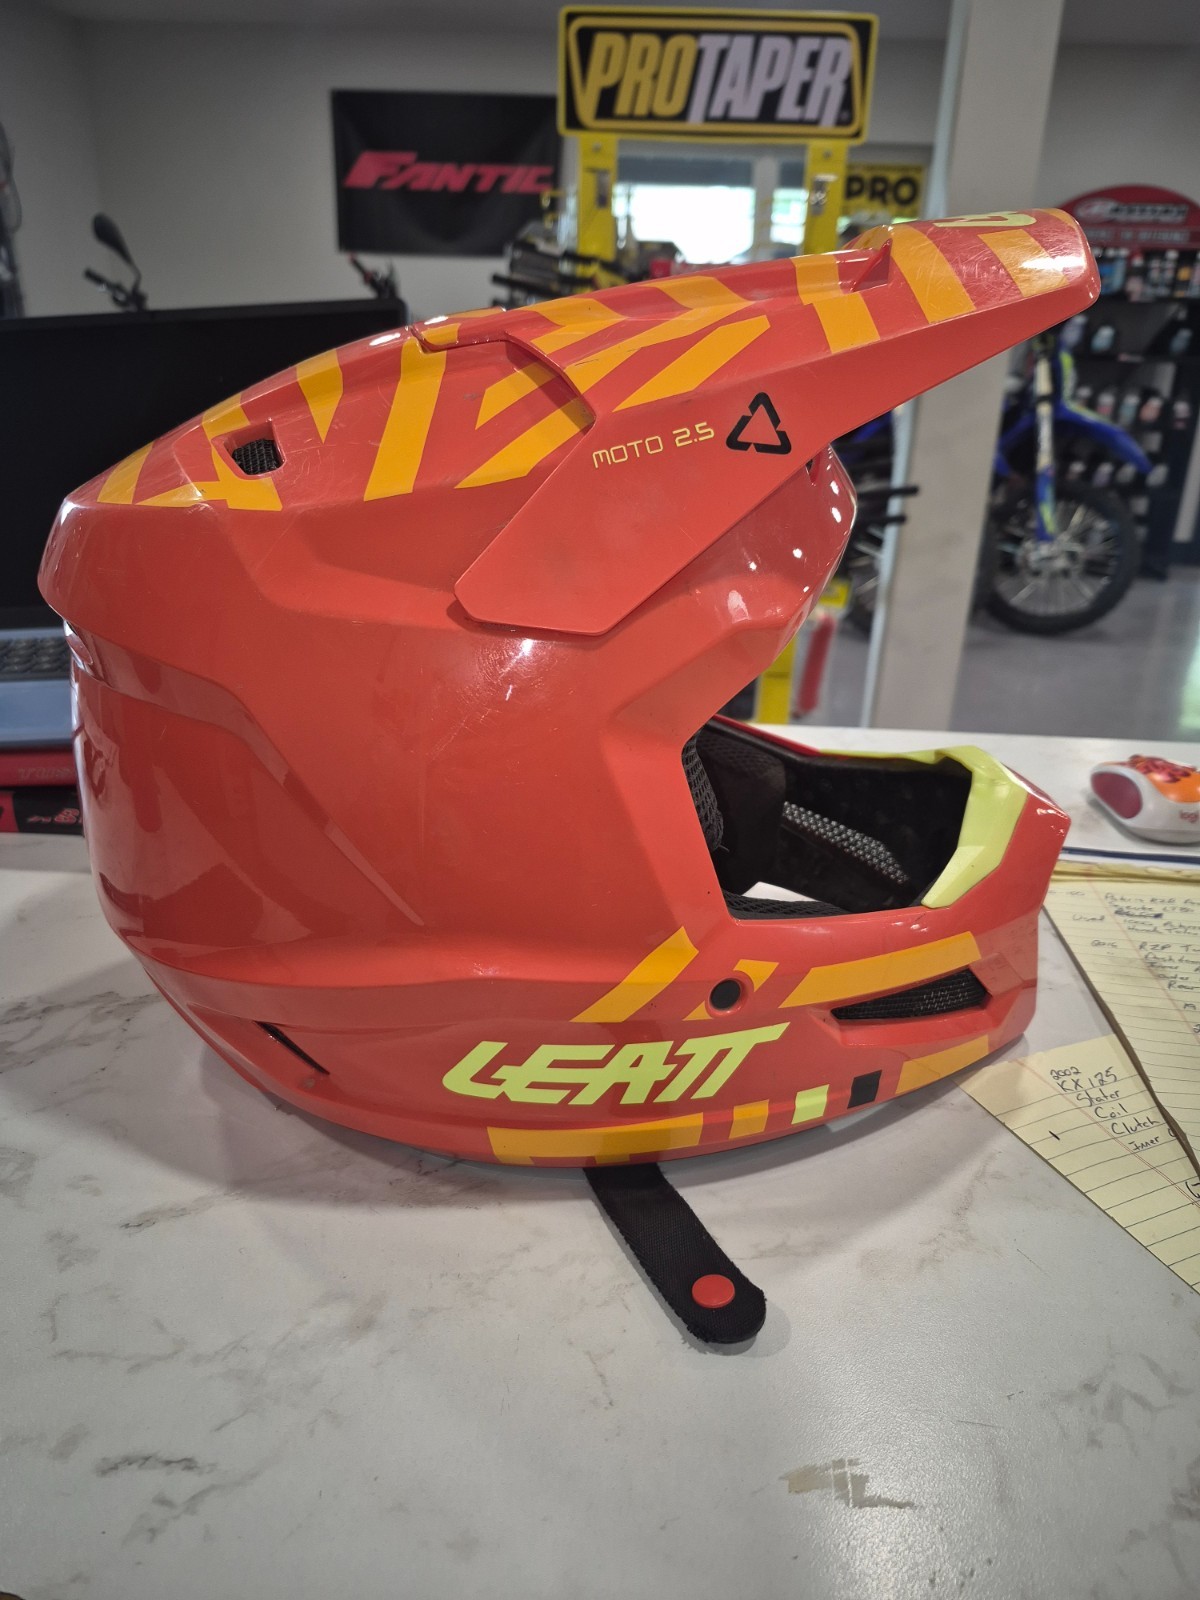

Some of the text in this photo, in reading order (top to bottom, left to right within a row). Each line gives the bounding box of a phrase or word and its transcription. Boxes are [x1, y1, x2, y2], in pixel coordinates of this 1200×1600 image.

[586, 31, 853, 128] PROTAPER
[343, 150, 556, 194] FANTIC
[845, 174, 918, 207] PRO
[591, 421, 716, 469] MOTO 2.5
[441, 1021, 791, 1106] LEATT
[1049, 1065, 1082, 1081] 2002
[1094, 1102, 1129, 1120] Coil
[1111, 1116, 1163, 1136] Clutch
